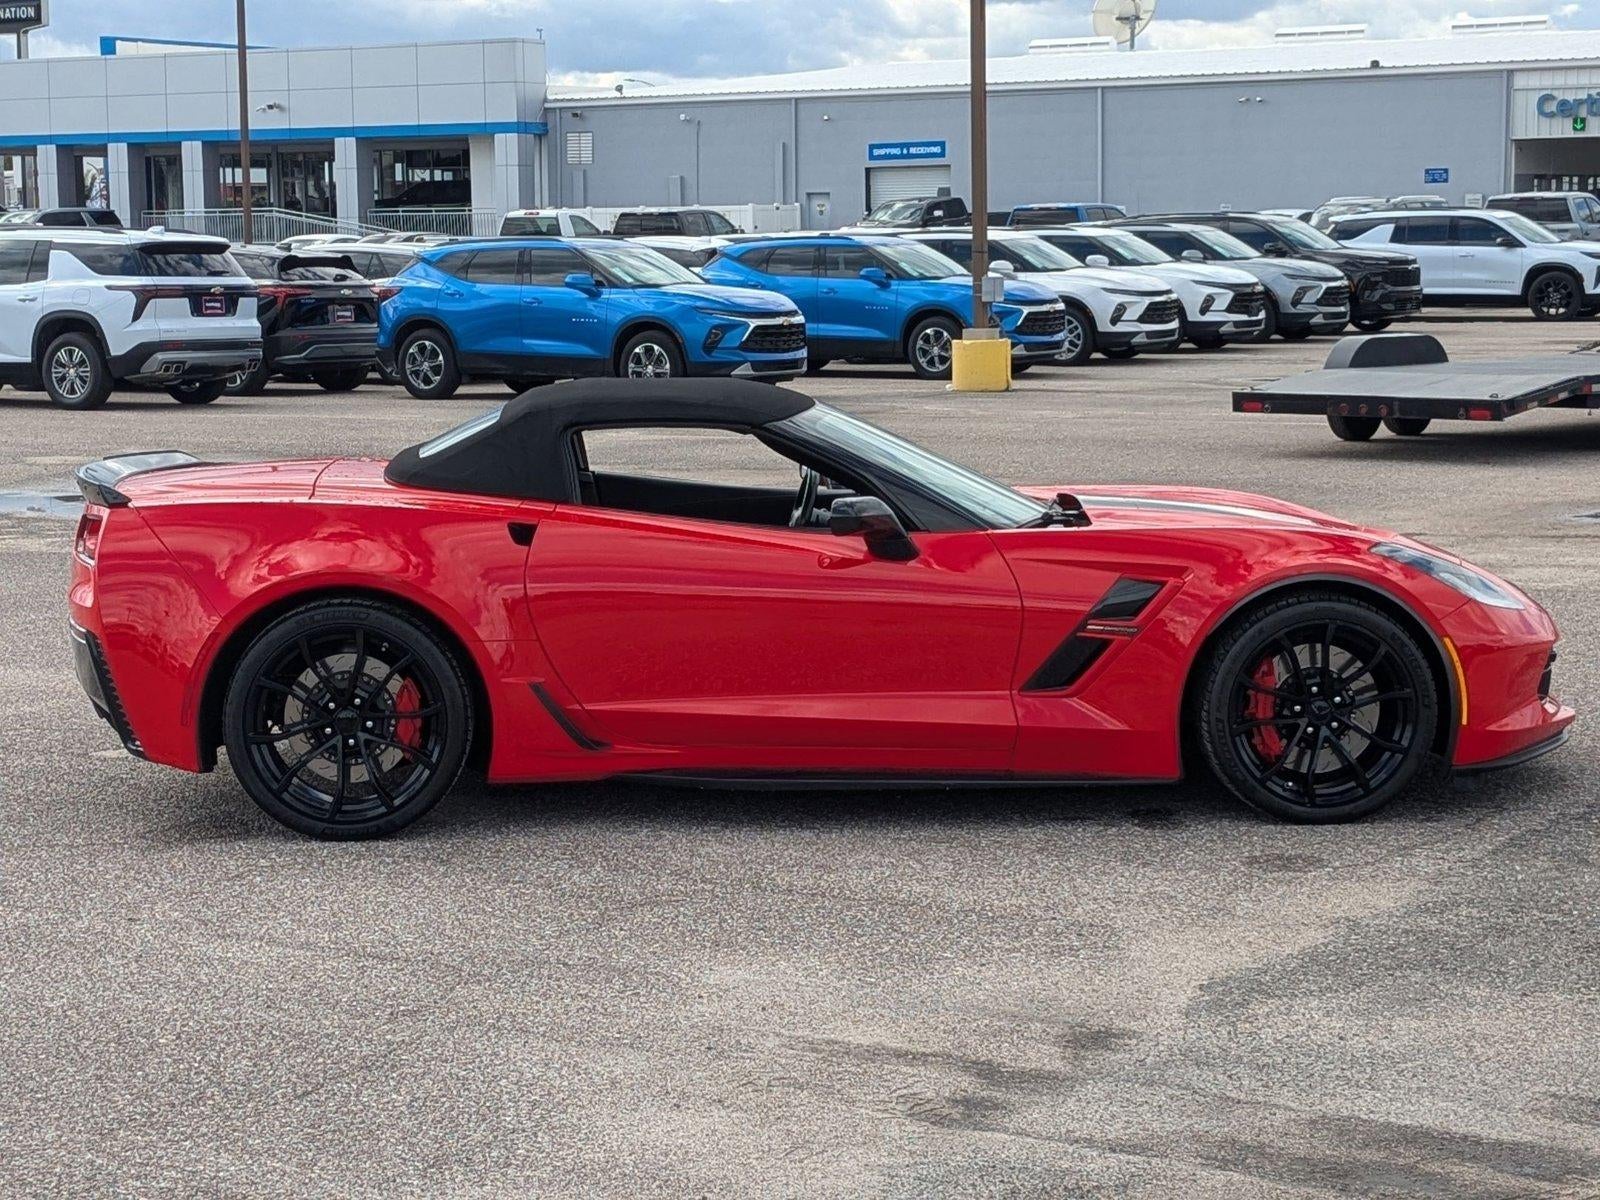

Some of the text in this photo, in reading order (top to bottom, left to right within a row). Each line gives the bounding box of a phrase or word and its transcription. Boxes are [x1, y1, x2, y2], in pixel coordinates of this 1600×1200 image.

[0, 6, 35, 19] NATION
[873, 148, 901, 156] SHIPPING
[909, 146, 941, 154] RECEIVING
